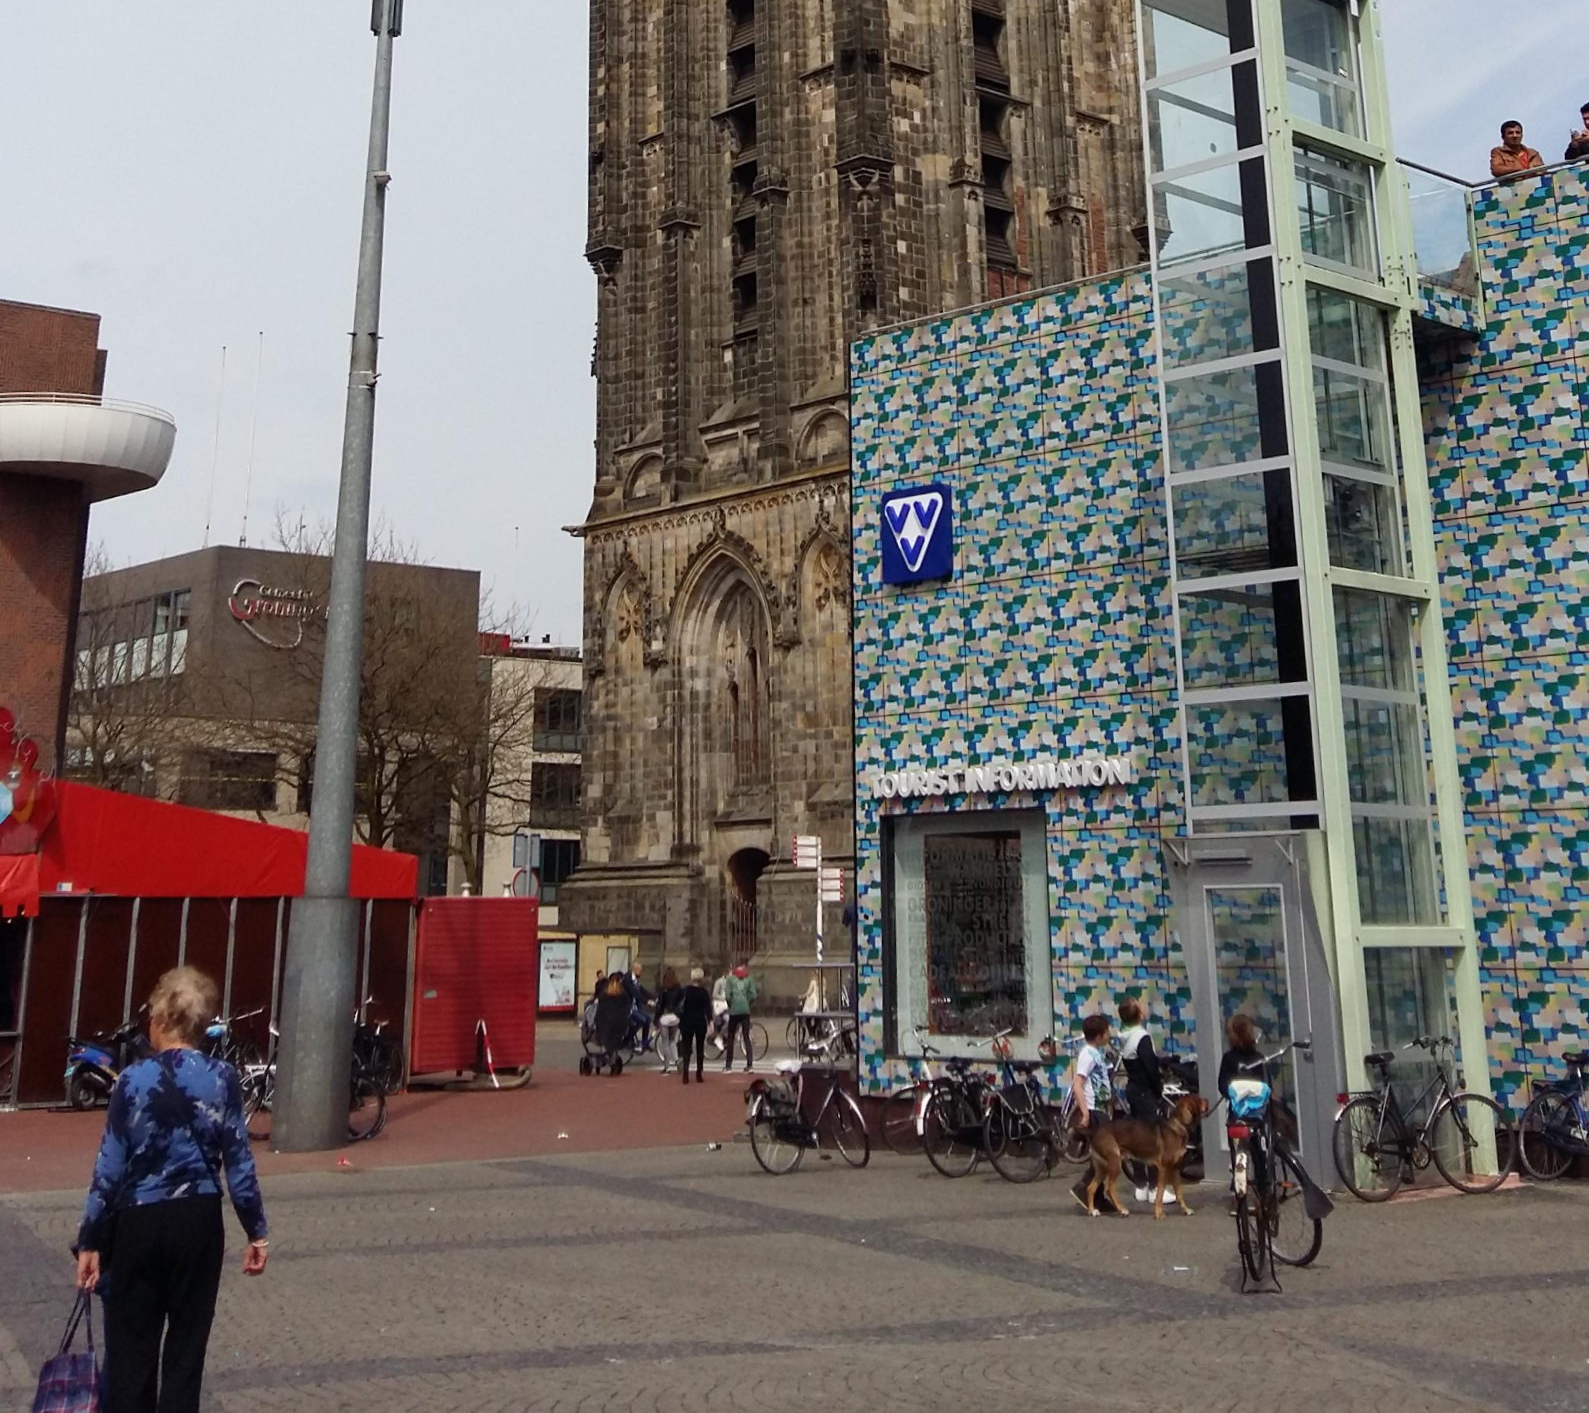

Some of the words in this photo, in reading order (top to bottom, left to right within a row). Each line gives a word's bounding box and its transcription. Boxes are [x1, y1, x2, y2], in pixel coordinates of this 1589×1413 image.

[870, 767, 963, 799] TOURIST
[965, 757, 1131, 794] INFORMATION
[907, 896, 992, 914] GRONINGER
